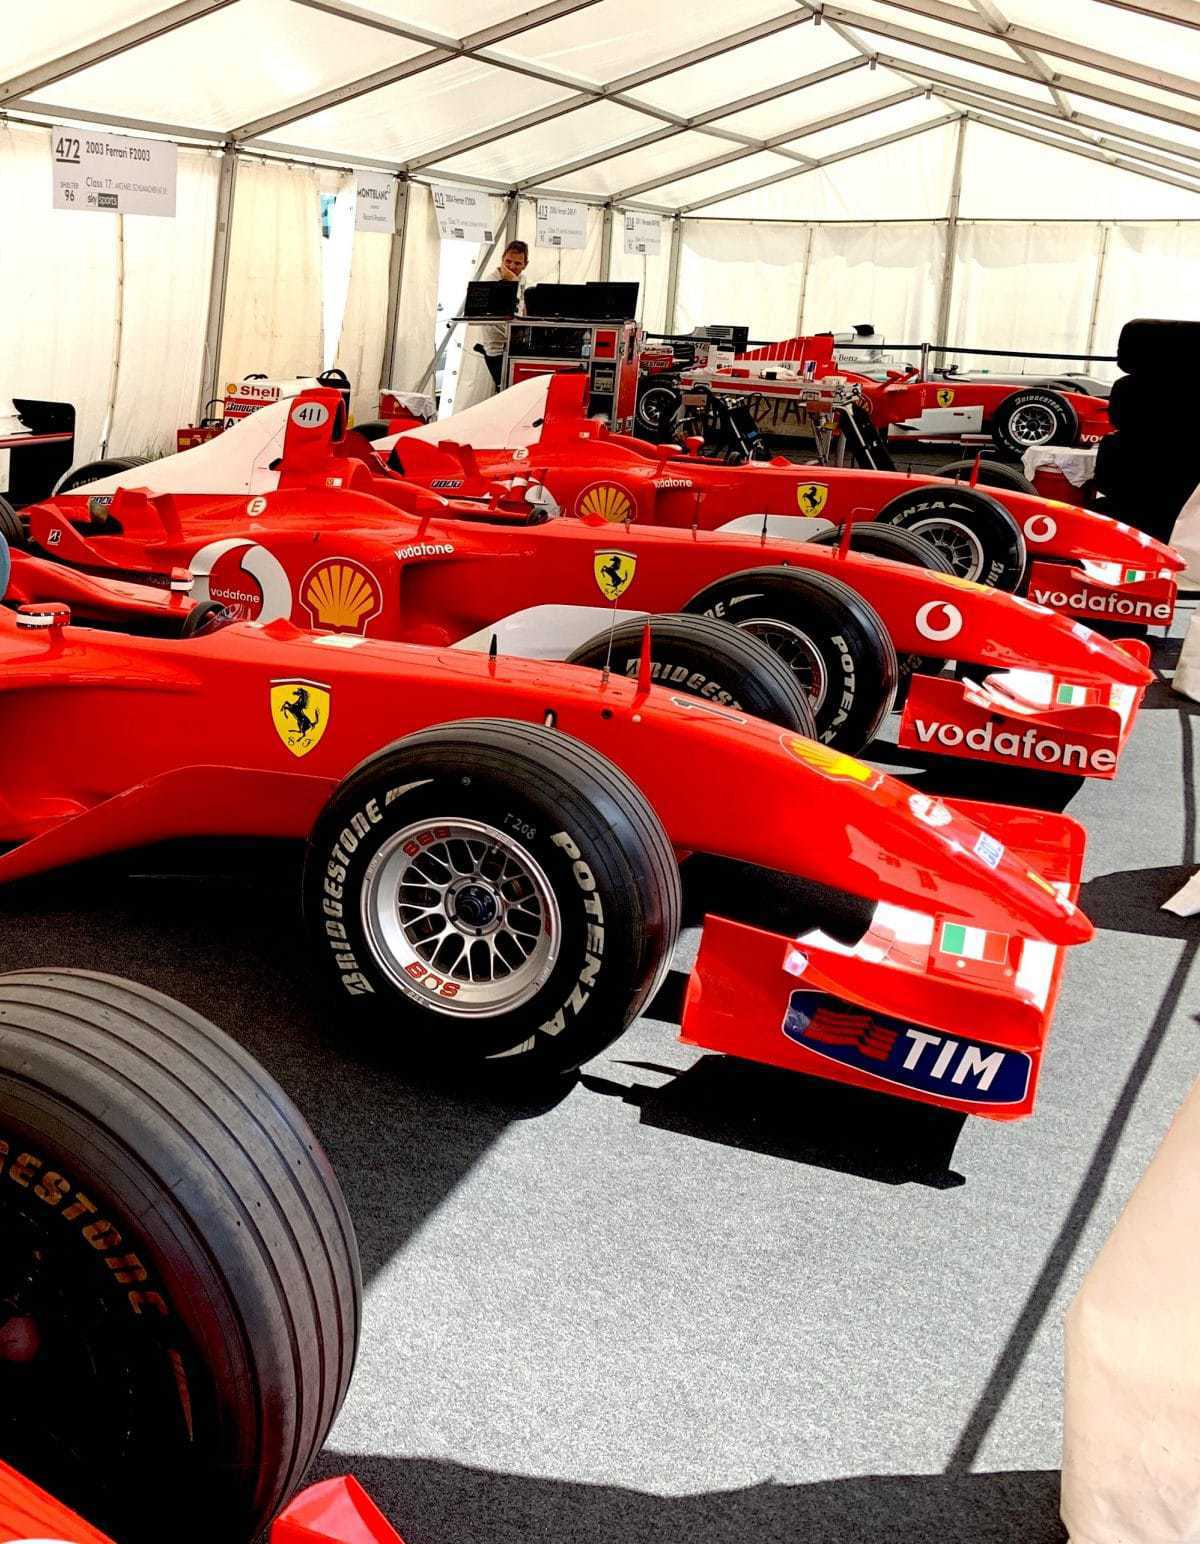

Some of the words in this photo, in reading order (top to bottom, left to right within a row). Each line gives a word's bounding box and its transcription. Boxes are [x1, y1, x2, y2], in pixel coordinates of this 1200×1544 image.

[55, 136, 81, 160] 472
[85, 140, 105, 156] 2003
[85, 176, 104, 189] Class
[64, 189, 75, 202] 96
[240, 385, 280, 399] Shell
[226, 402, 260, 413] BRIDGE
[299, 407, 322, 423] 411
[249, 498, 264, 514] E
[889, 501, 947, 526] ENZA
[394, 541, 455, 561] vodafone
[210, 586, 261, 604] vodafone
[1033, 588, 1171, 620] vodafone
[819, 635, 856, 745] POTENZ
[914, 718, 1118, 773] vodafone
[322, 797, 385, 997] BRIDGESTONE
[538, 831, 606, 1038] POTENZA
[901, 1027, 1006, 1092] TIM
